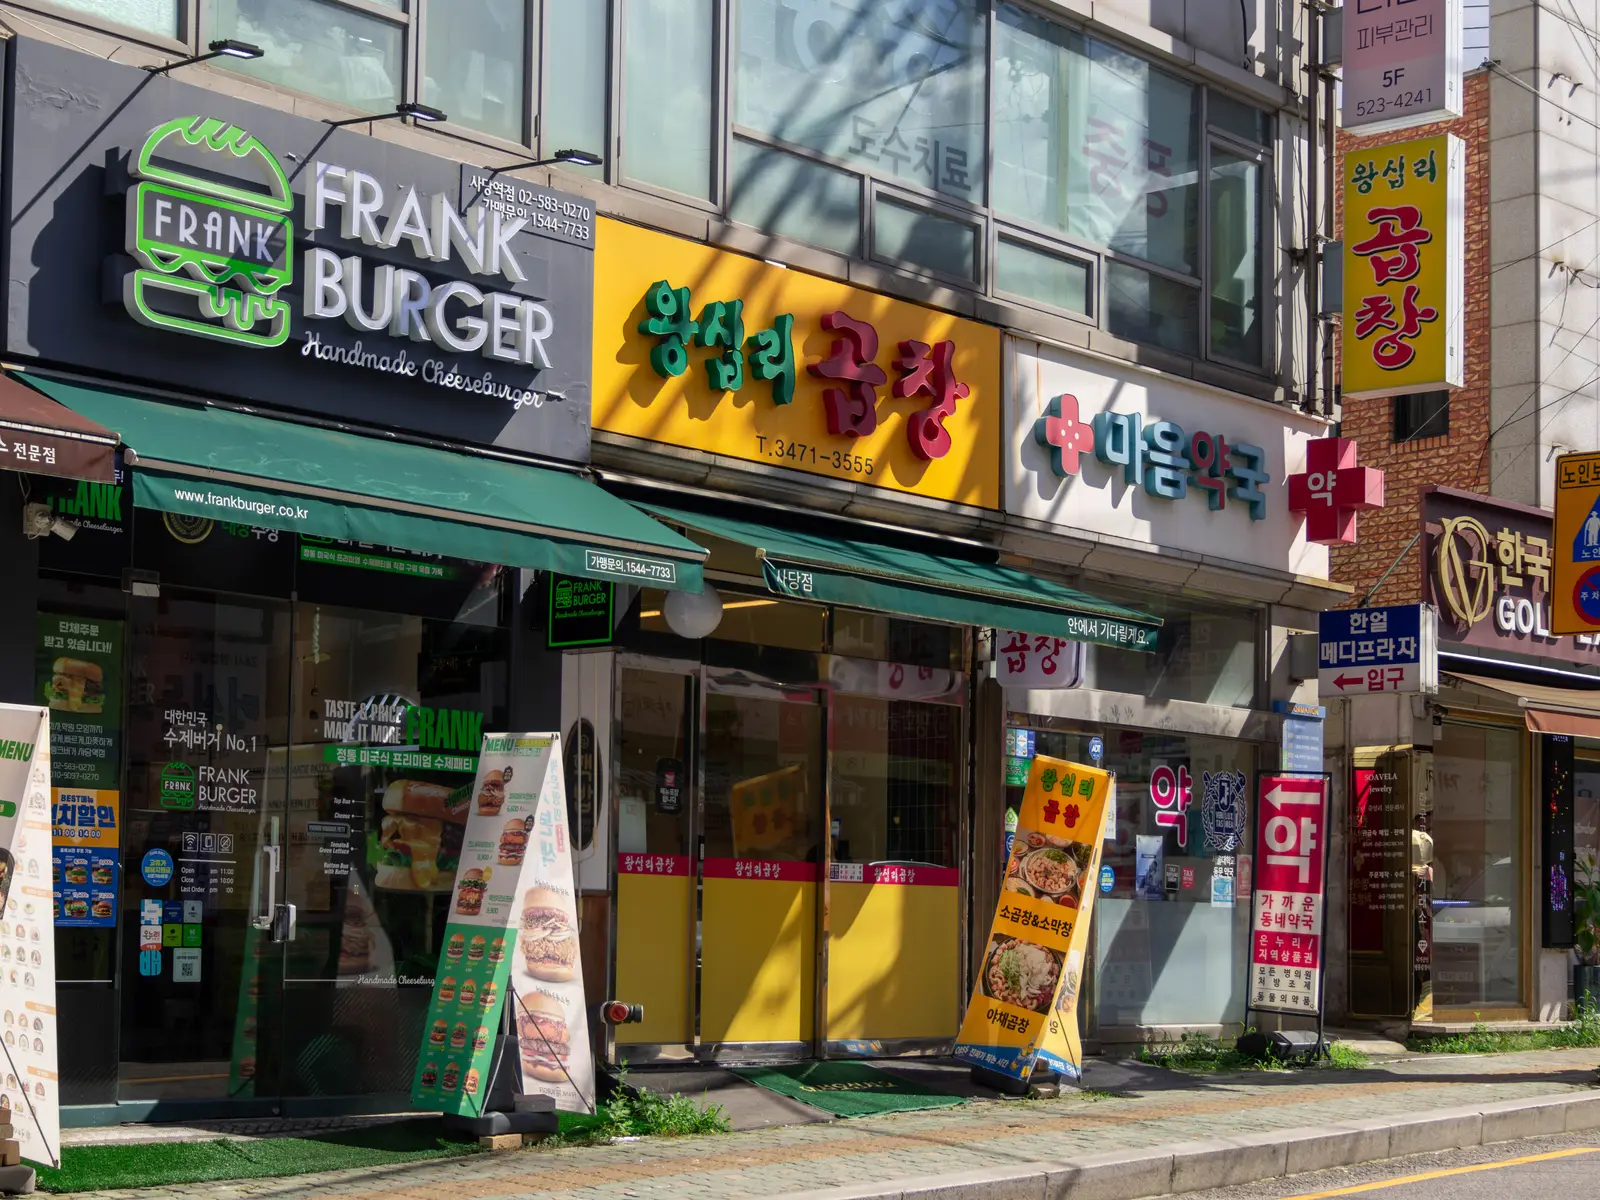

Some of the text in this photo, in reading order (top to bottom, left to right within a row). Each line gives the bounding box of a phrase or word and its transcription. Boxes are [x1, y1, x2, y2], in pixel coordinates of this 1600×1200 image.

[1357, 15, 1432, 50] 피부관리
[1383, 68, 1405, 87] 5F
[1356, 88, 1431, 116] 523-4241
[848, 115, 971, 192] 도수치료
[1352, 150, 1437, 194] 왕십리
[469, 174, 590, 222] 사당역점 02-583-0270
[154, 200, 275, 262] FRANK
[305, 159, 528, 283] FRANK
[531, 212, 590, 240] 1544-7733
[1352, 205, 1438, 369] 곱창
[304, 248, 554, 369] BURGER
[301, 330, 544, 409] Handmade Cheeseburger
[638, 279, 970, 461] 왕십리 곱창
[14, 442, 56, 464] 전문점
[756, 435, 875, 476] T.3471-3555
[1095, 411, 1271, 521] 마음약국
[1307, 470, 1337, 507] 약
[174, 487, 309, 520] www.frankburger.co.kr
[591, 555, 671, 579] 가맹문의.1544-7733
[573, 580, 603, 593] FRANK
[776, 571, 813, 592] 사당점
[573, 592, 607, 606] BURGER
[59, 621, 99, 637] 단체주문
[1067, 617, 1150, 645] 안에서 기다릴게요.
[1350, 612, 1388, 634] 한얼
[1320, 637, 1417, 664] 메디프라자
[1367, 667, 1405, 692] 입구
[164, 710, 208, 727] 대한민국
[324, 699, 401, 724] TASTE & PRICE
[323, 721, 401, 744] MADE IT MORE
[406, 705, 484, 751] FRANK
[0, 740, 35, 762] MENU
[163, 729, 257, 752] 수제버거 No.1
[484, 738, 515, 752] MENU
[337, 748, 473, 771] 정통 미국식 프리미엄 수제패티
[164, 781, 191, 791] FRANK
[198, 766, 250, 785] FRANK
[1041, 768, 1095, 801] 왕십리
[1364, 773, 1398, 781] SOAVELA
[198, 786, 257, 804] BURGER
[1370, 785, 1393, 794] jewelry
[1043, 799, 1080, 828] 곱창
[1150, 764, 1193, 848] 약
[1265, 815, 1317, 884] 약
[180, 867, 195, 875] Open
[624, 855, 675, 874] 왕십리곱창
[734, 861, 782, 879] 왕십리곱창
[874, 867, 915, 883] 왕십리곱창
[1261, 894, 1315, 912] 가까운
[999, 905, 1073, 938] 소곱창&소막창
[1260, 911, 1314, 931] 동네약국
[1258, 949, 1313, 964] 지역상품권
[358, 974, 397, 985] Handmade
[1258, 966, 1276, 977] 모든
[1257, 991, 1311, 1006] 동물의약품
[987, 1008, 1030, 1034] 야채곱창
